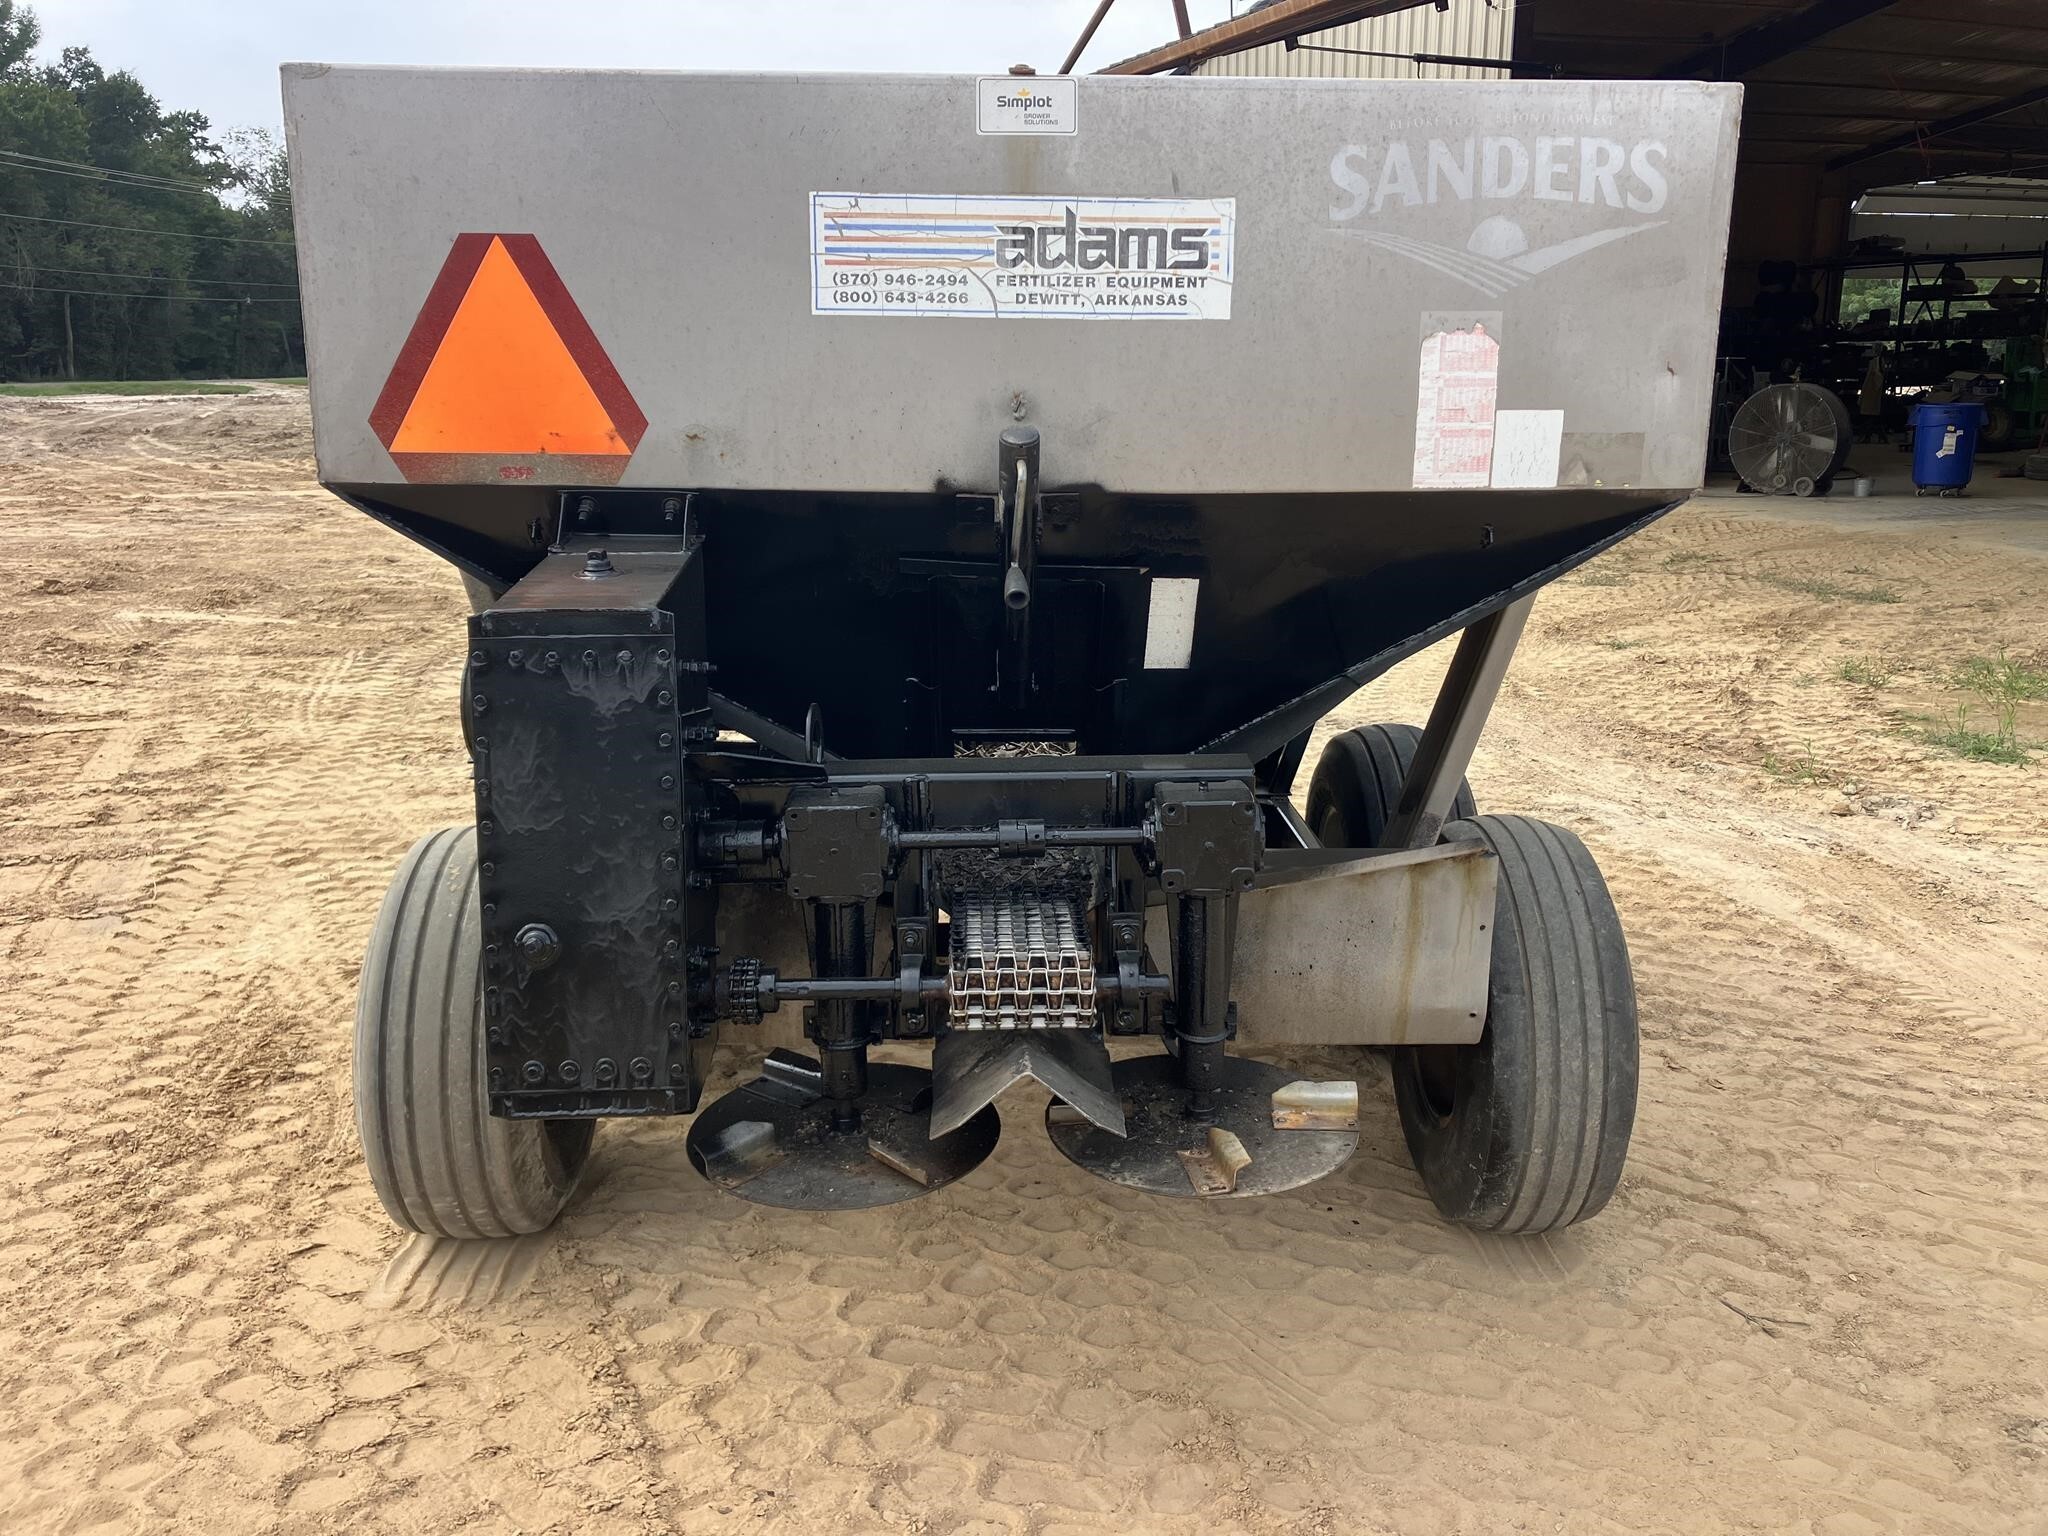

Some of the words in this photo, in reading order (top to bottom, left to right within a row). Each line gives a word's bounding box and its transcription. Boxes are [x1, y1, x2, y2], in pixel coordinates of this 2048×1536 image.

[997, 95, 1052, 111] Simplot
[1329, 135, 1668, 221] SANDERS
[995, 205, 1209, 270] adams
[832, 272, 878, 287] (870)
[884, 273, 969, 286] 946-2494
[995, 274, 1096, 288] FERTILIZER
[1106, 276, 1208, 289] EQUIPMENT
[833, 289, 878, 304] (800)
[884, 291, 969, 304] 643-4266
[1015, 293, 1085, 308] DEWITT,
[1094, 293, 1188, 306] ARKANSAS
